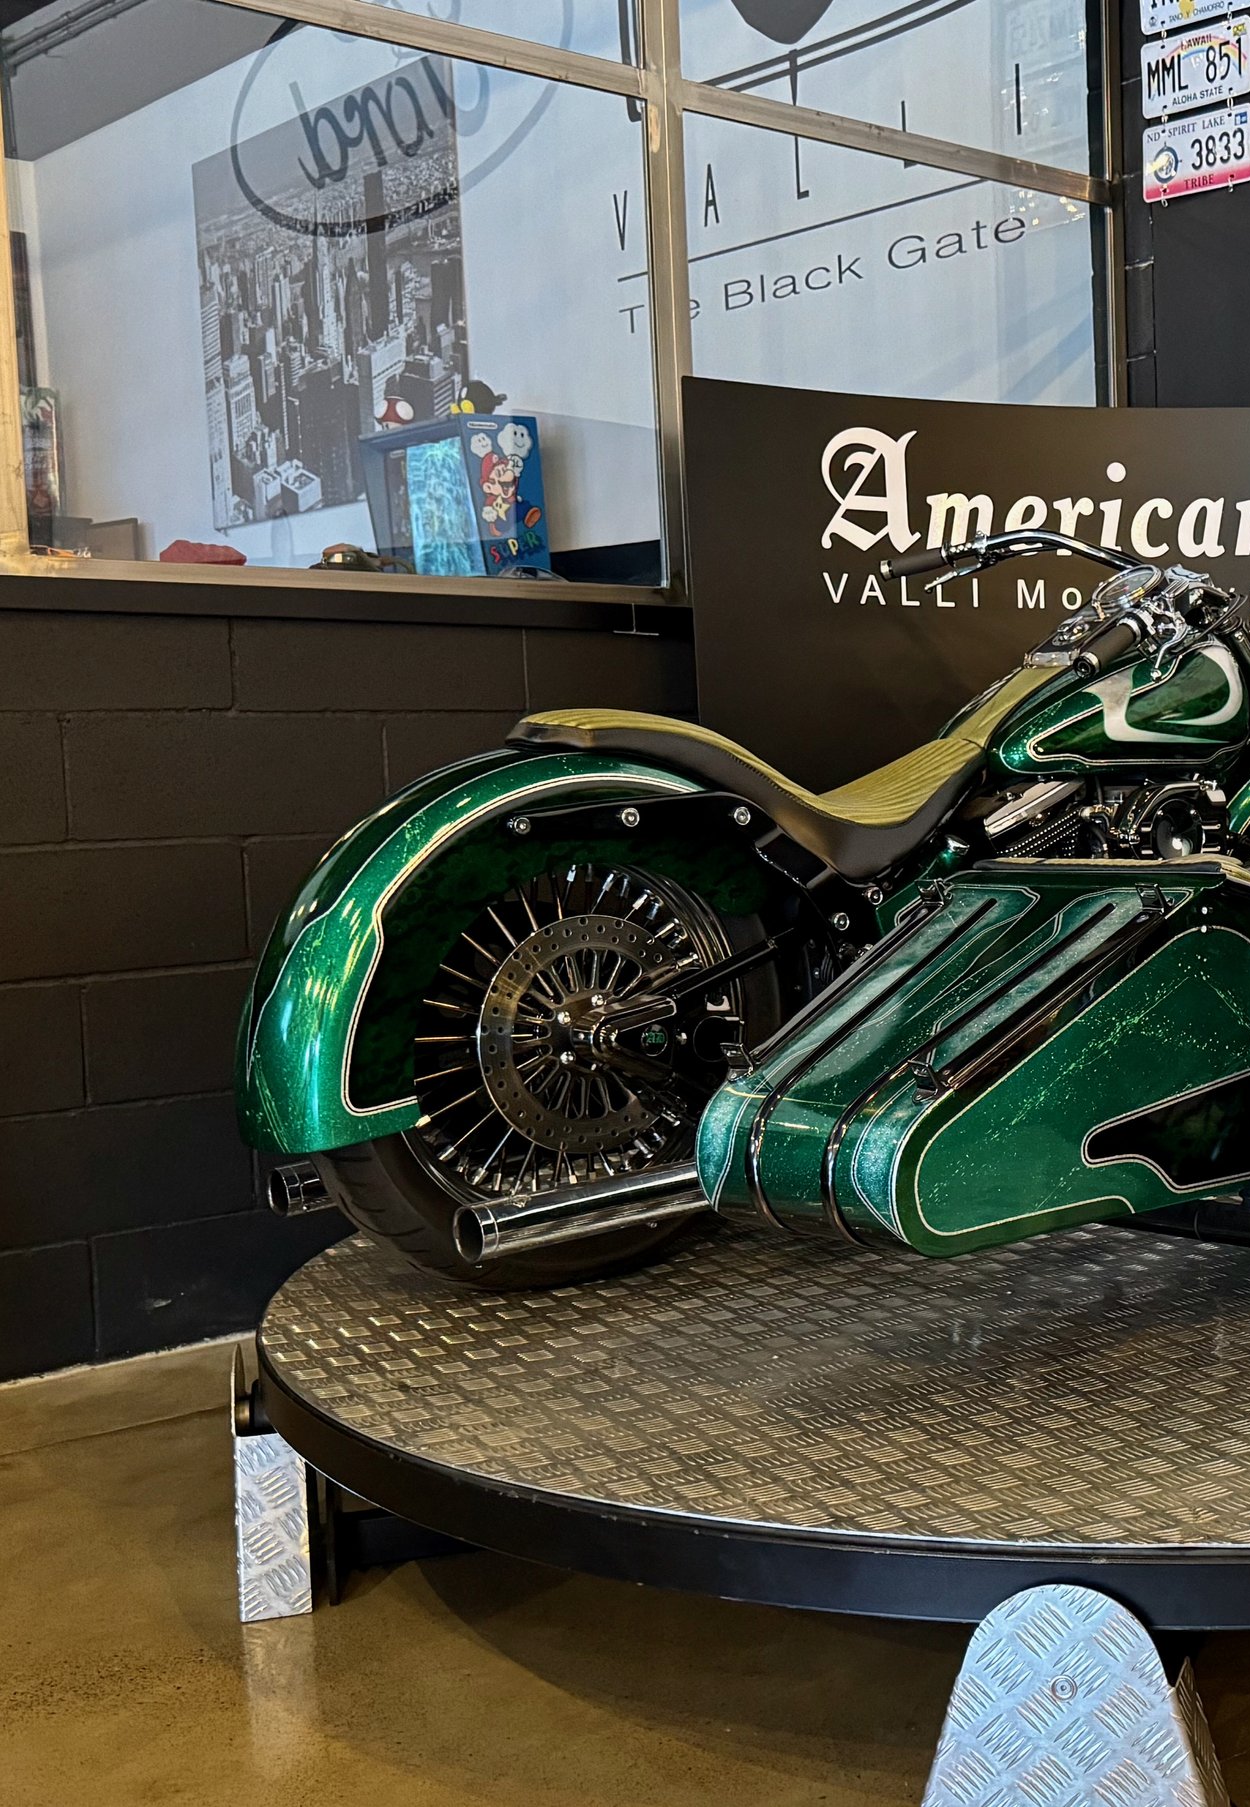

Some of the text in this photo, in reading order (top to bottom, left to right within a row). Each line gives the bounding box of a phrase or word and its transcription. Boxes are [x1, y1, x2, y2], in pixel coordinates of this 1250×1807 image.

[1147, 37, 1243, 100] MML 851
[1172, 86, 1224, 106] ALOHA STATE
[1147, 131, 1161, 143] ND
[1168, 122, 1198, 138] SPIRIT
[1202, 115, 1226, 130] LAKE
[1190, 127, 1246, 171] 3833
[1184, 174, 1215, 190] TRIBE
[723, 253, 864, 312] Black
[887, 216, 1026, 269] Gate
